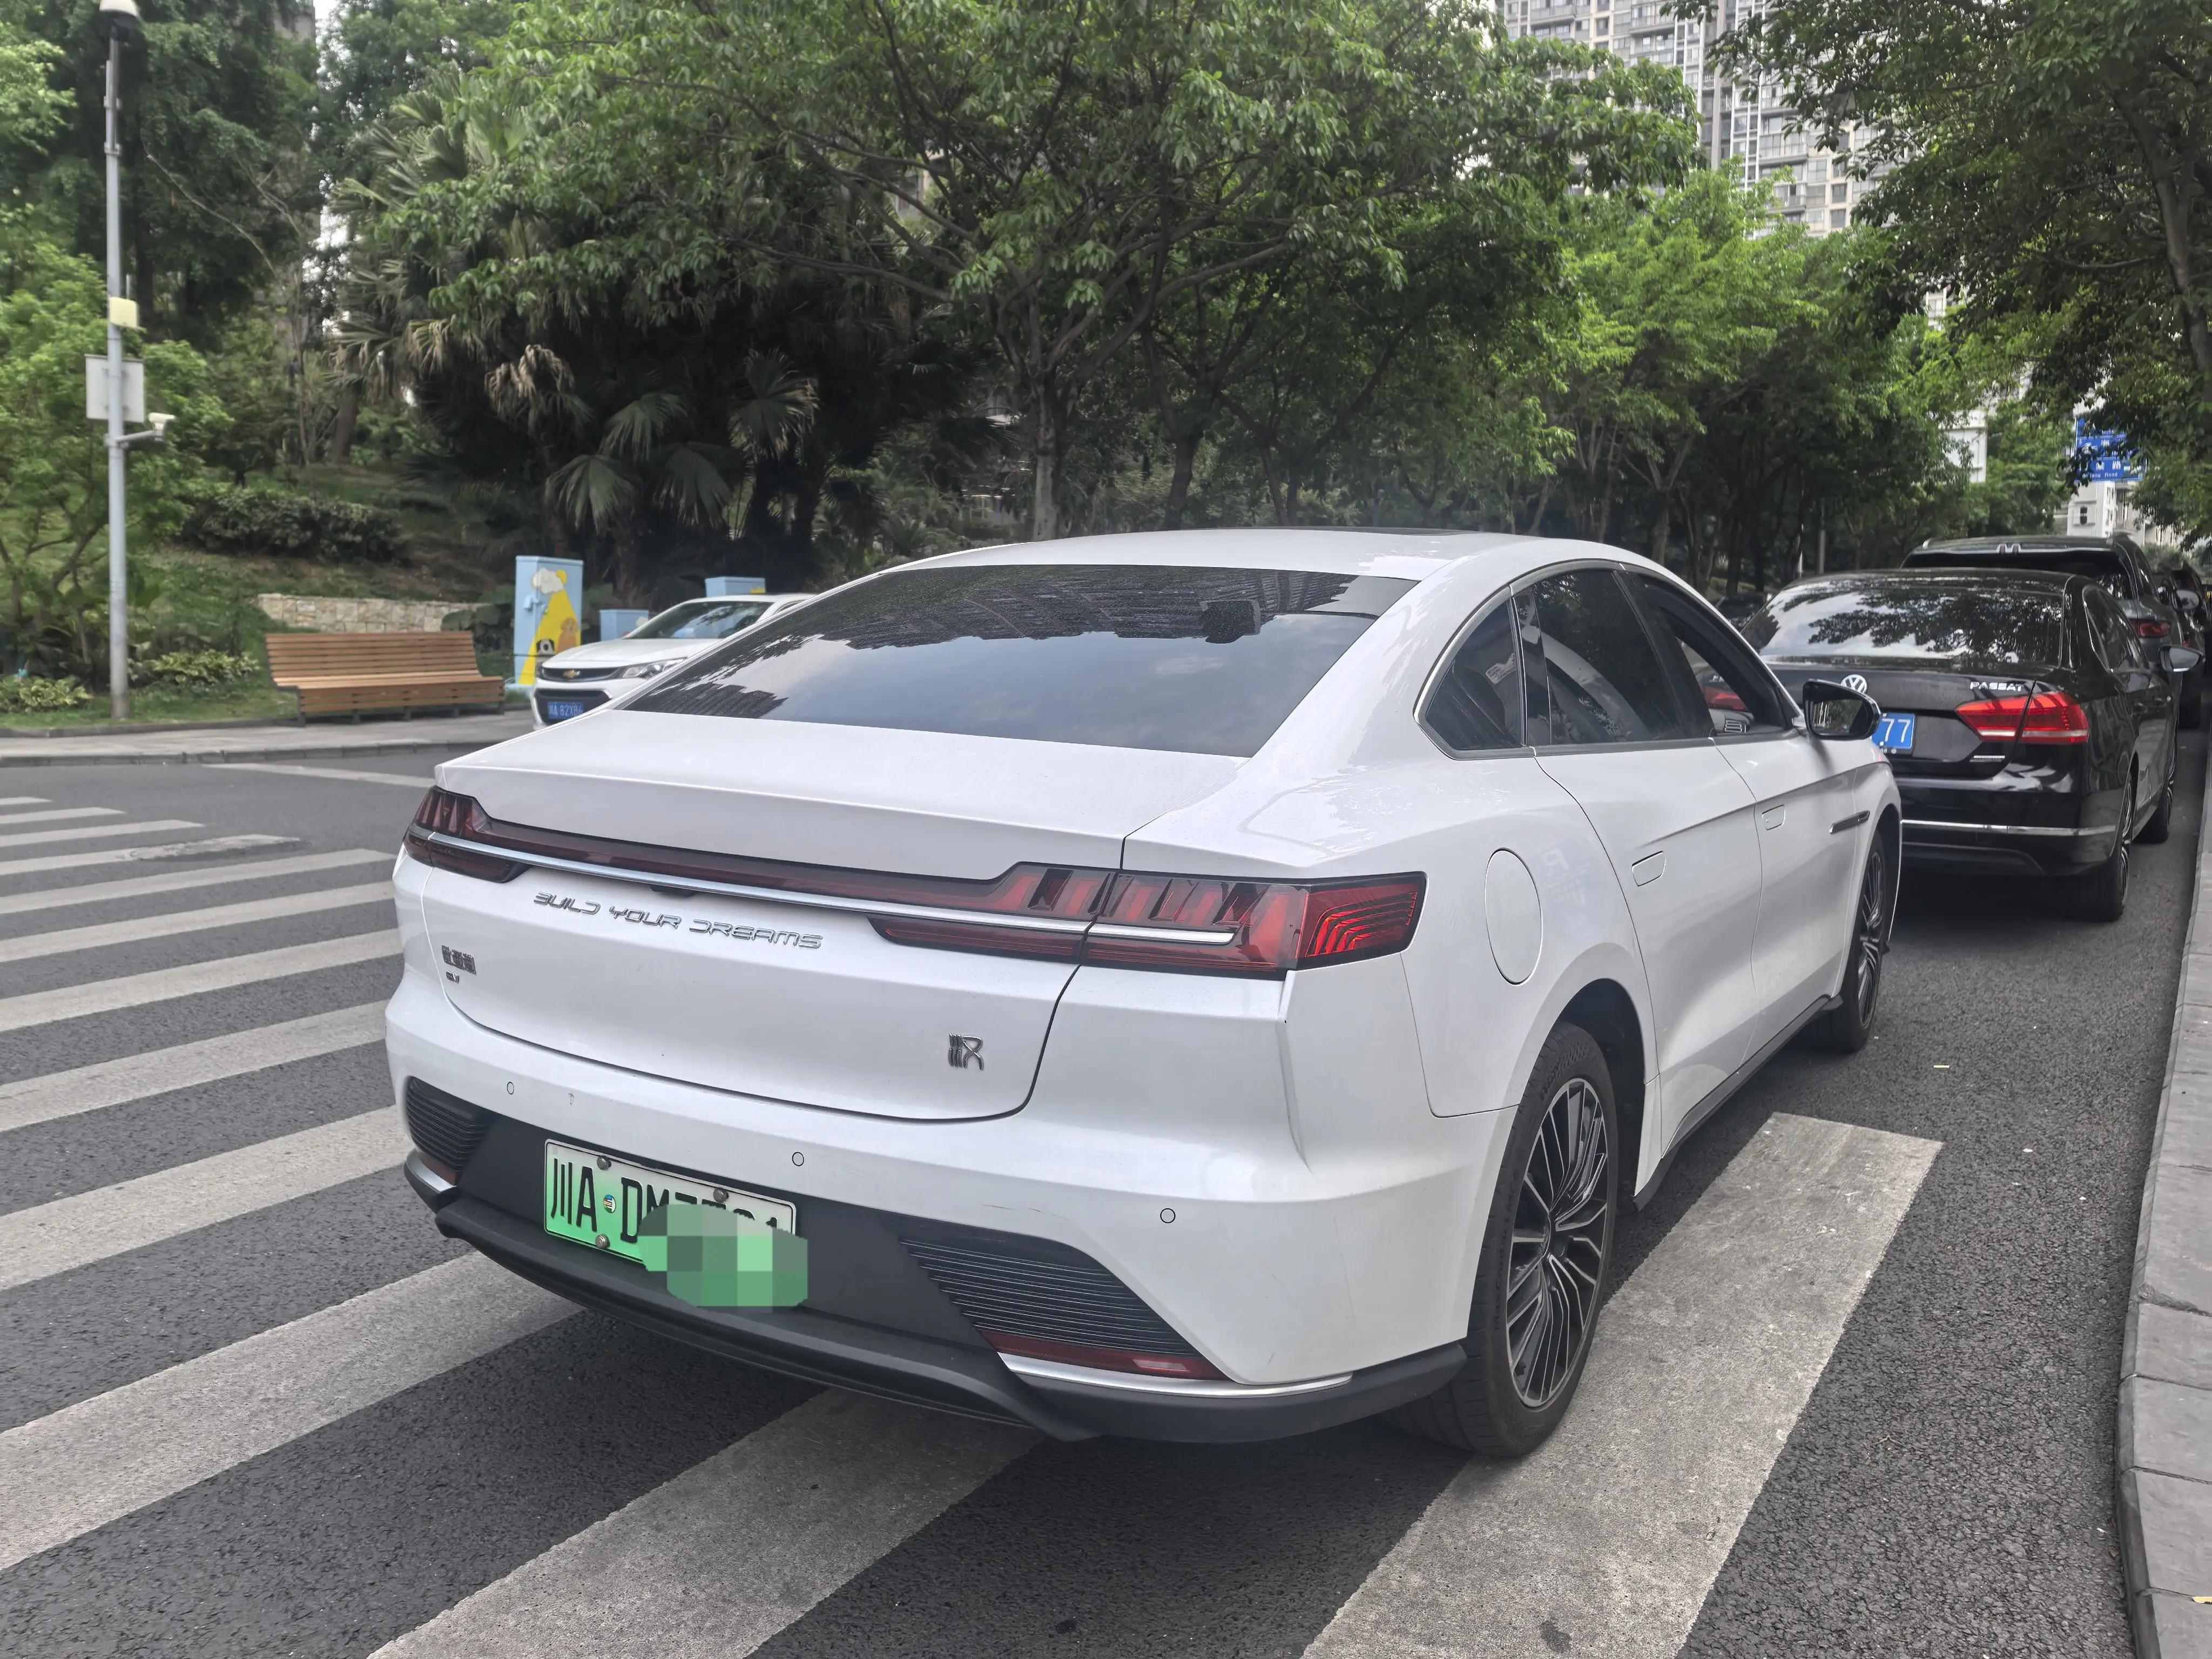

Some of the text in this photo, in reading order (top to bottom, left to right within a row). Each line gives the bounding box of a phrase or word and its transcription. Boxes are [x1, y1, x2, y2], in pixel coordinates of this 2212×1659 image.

[1970, 682, 2024, 692] PASSAT
[534, 892, 824, 949] BUILD YOUR DREAMS
